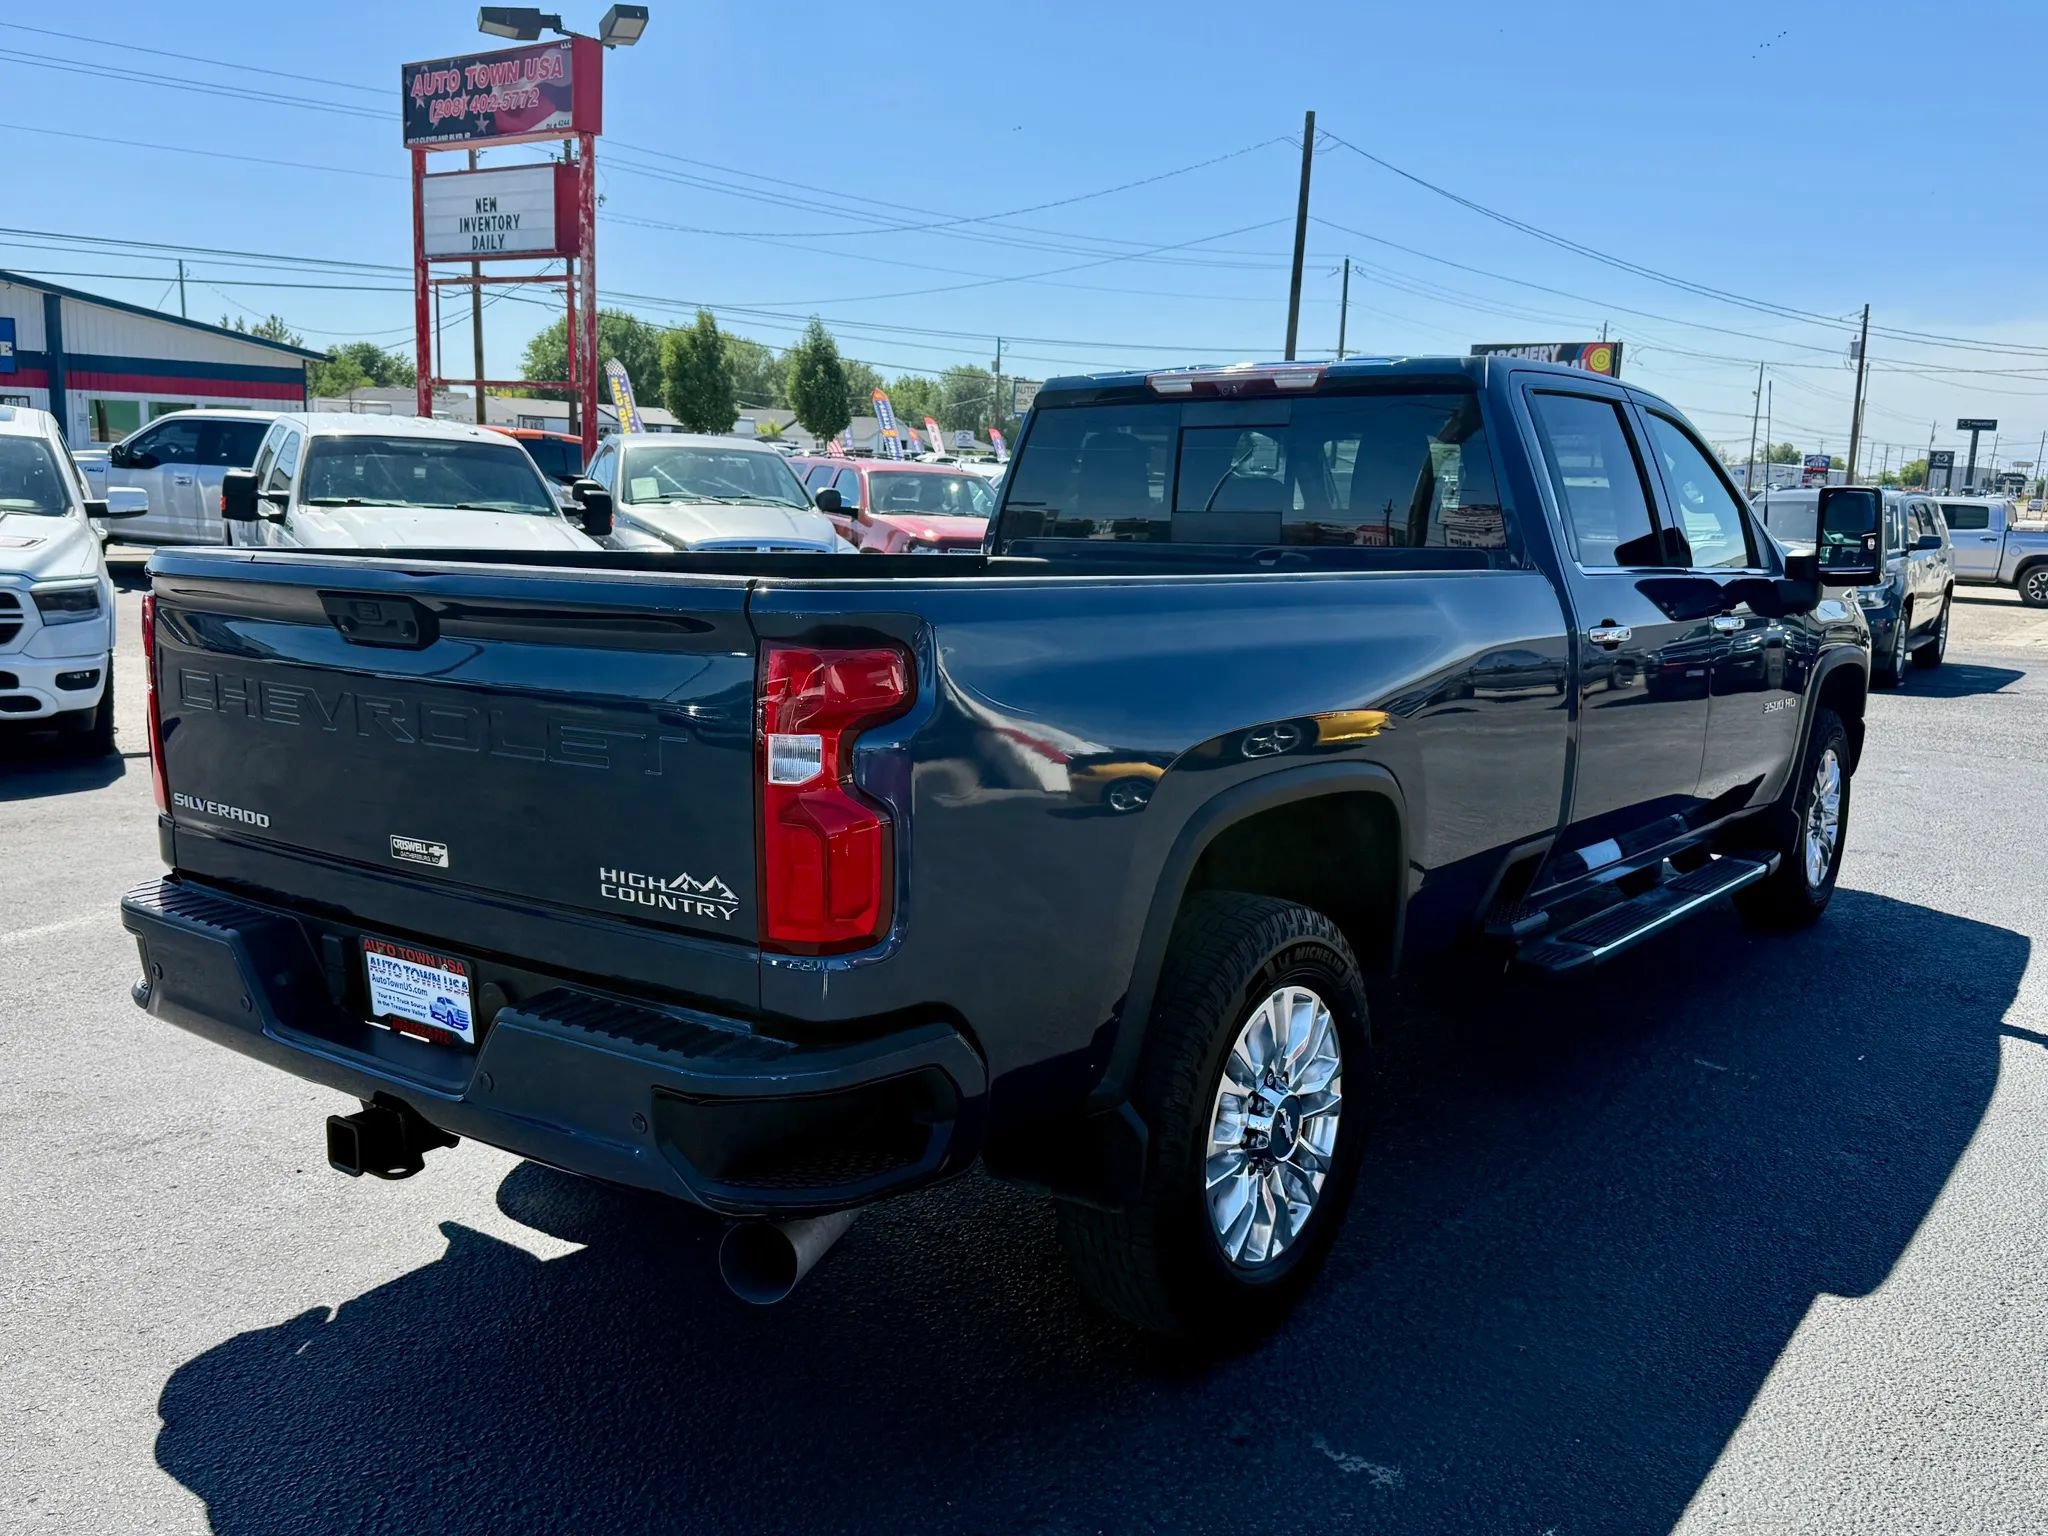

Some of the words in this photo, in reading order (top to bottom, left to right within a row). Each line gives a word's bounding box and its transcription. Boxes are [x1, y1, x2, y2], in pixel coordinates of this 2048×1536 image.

[560, 41, 572, 49] LLC
[411, 69, 460, 97] AUTO
[465, 60, 520, 90] TOWN
[524, 55, 563, 82] USA
[429, 97, 466, 123] (208)
[470, 88, 540, 114] 402-5772
[419, 134, 448, 144] CLEVELAND
[475, 197, 497, 213] NEW
[459, 214, 520, 233] INVENTORY
[471, 234, 505, 250] DAILY
[1763, 699, 1784, 713] 3500
[1785, 697, 1796, 709] HD
[179, 668, 689, 776] CHEVROLET
[173, 792, 270, 828] SILVERADO
[393, 838, 428, 854] CRISWELL
[600, 867, 666, 892] HIGH
[601, 883, 739, 920] COUNTRY
[364, 938, 396, 956] AUTO
[399, 947, 435, 966] TOWN
[440, 957, 465, 975] USA
[1295, 946, 1345, 971] MICHELIN
[369, 957, 402, 978] AUTO
[402, 964, 441, 990] TOWN
[443, 975, 470, 997] USA
[372, 973, 428, 996] AutoTownUS.com
[391, 1003, 411, 1013] Treasure
[396, 996, 410, 1005] Truck
[410, 1000, 427, 1010] Source
